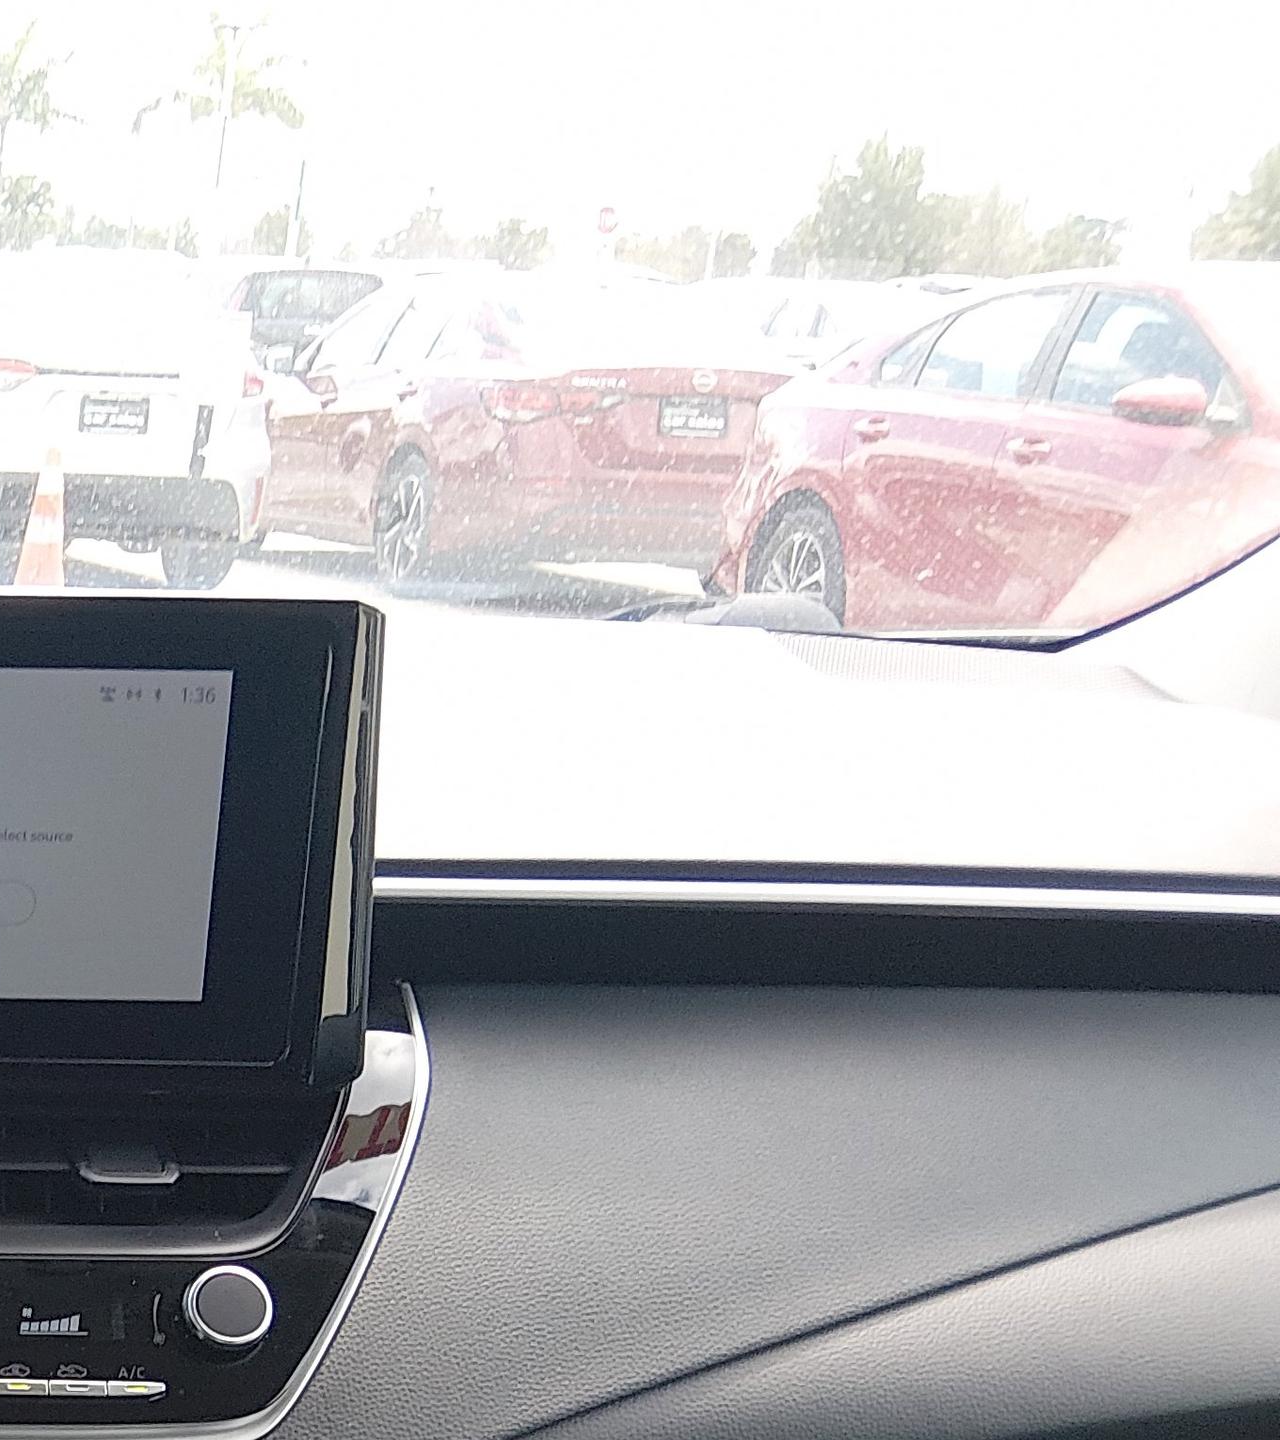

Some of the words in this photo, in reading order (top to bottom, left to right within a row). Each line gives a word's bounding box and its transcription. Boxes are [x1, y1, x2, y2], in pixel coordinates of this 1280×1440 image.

[183, 686, 216, 704] 1:36
[30, 832, 73, 844] source
[118, 1366, 146, 1379] A/C
